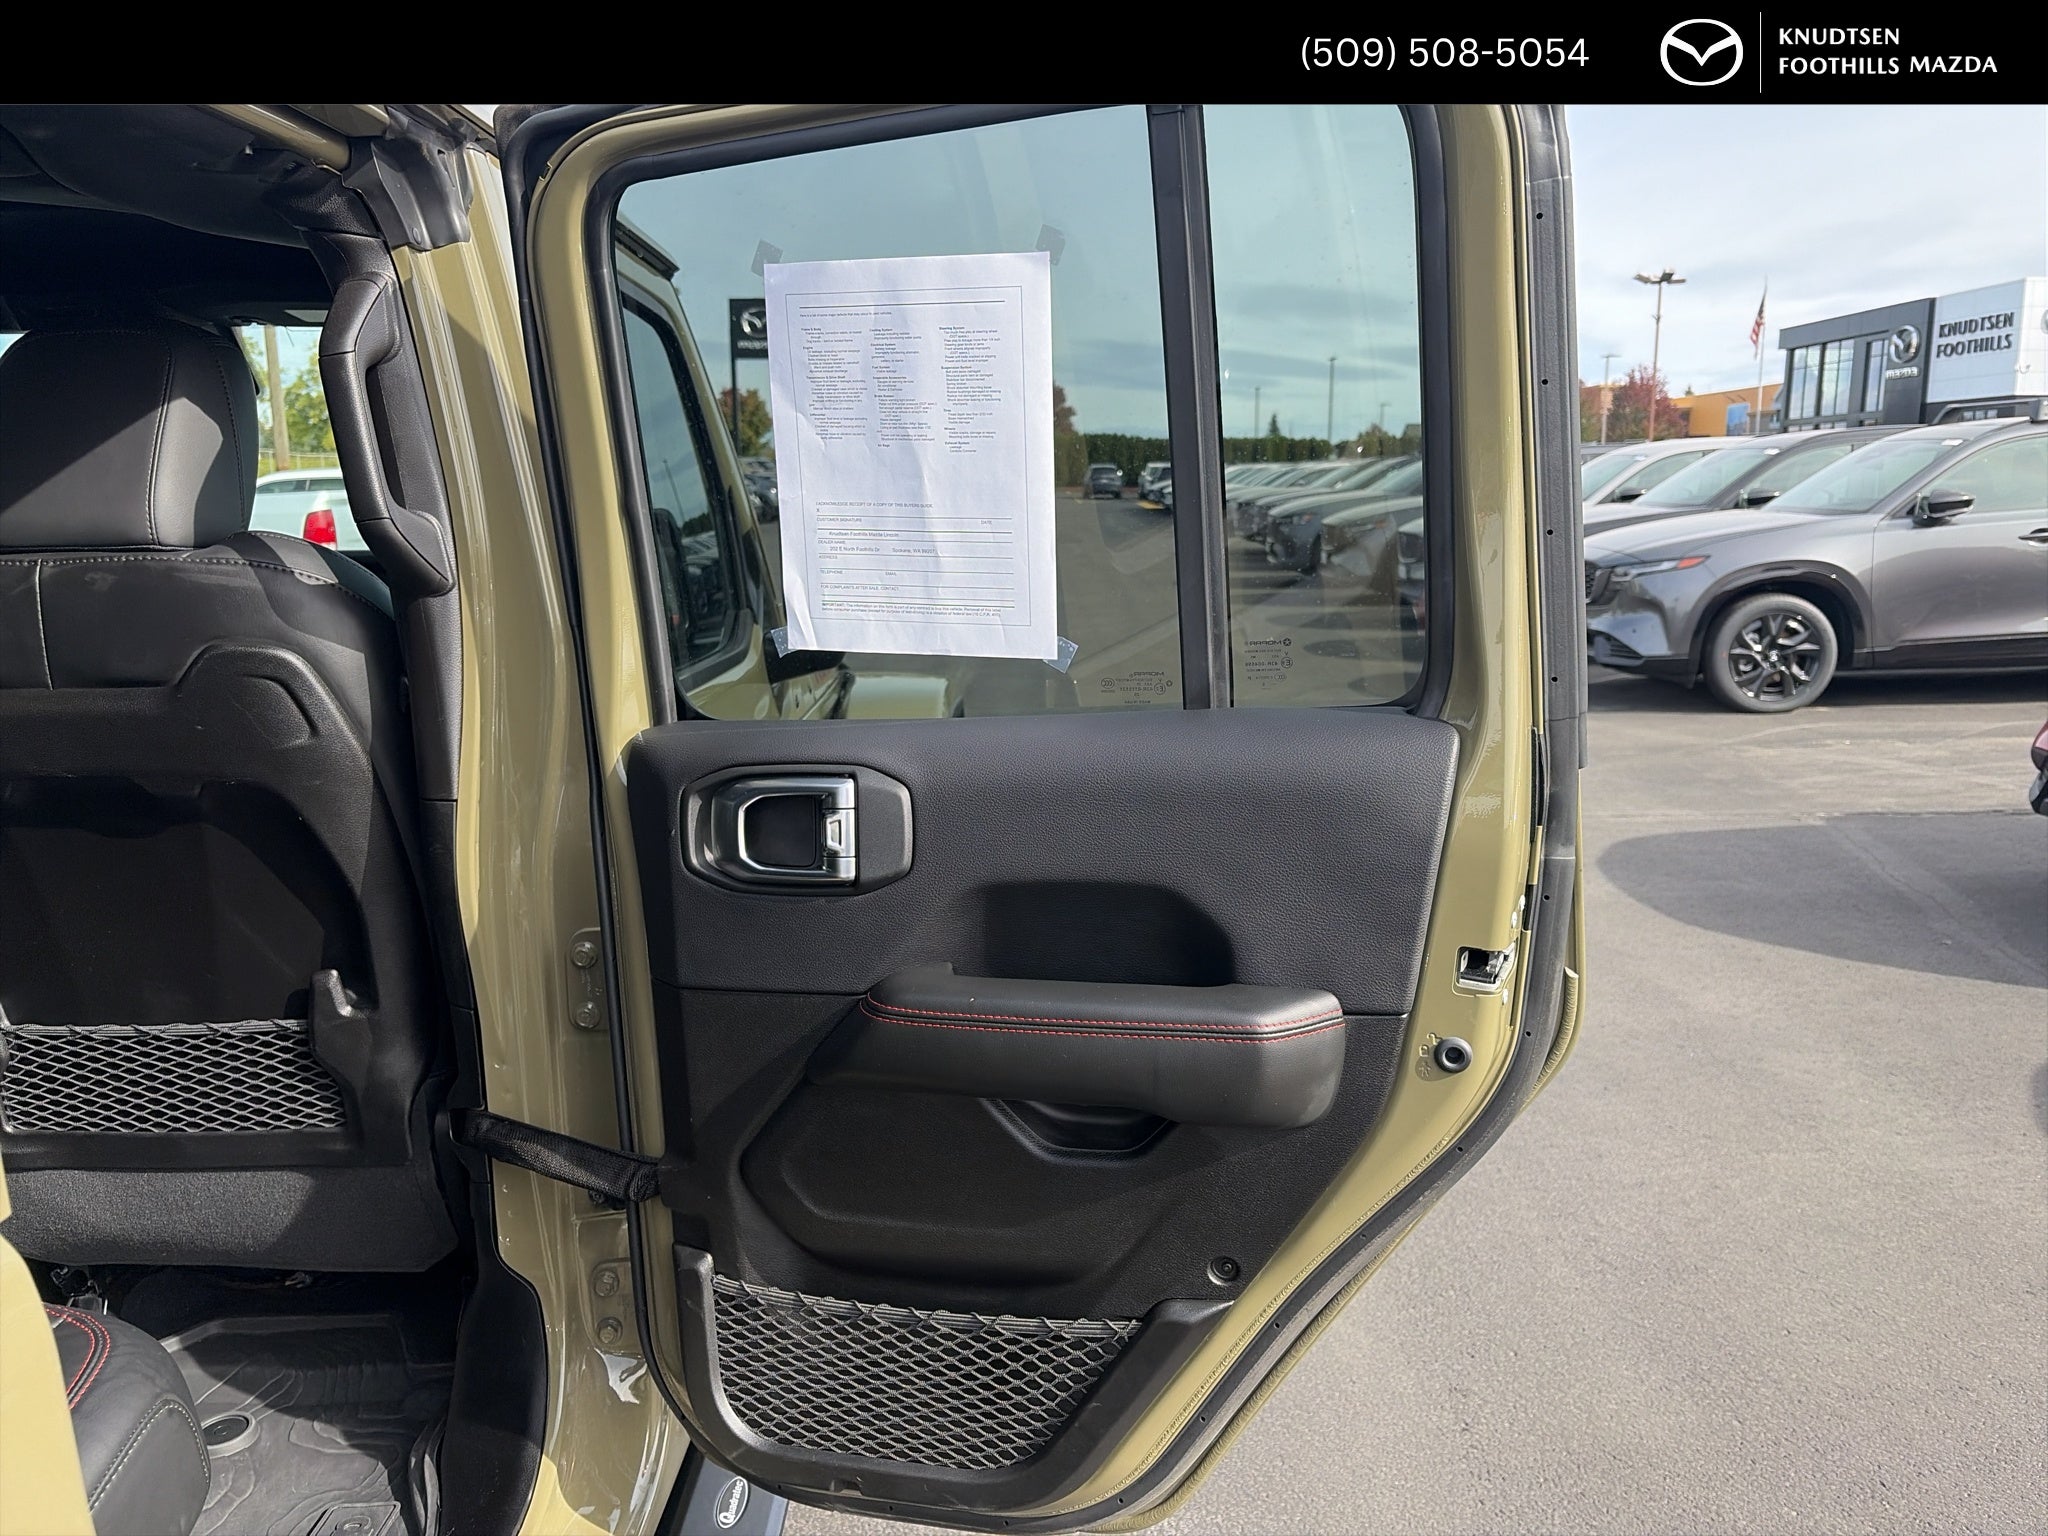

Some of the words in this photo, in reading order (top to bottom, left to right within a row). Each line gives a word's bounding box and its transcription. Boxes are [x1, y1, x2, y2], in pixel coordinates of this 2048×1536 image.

[1939, 312, 2014, 338] KNUDTSEN
[1936, 334, 2012, 358] FOOTHILLS
[720, 1480, 743, 1524] Quadratec
